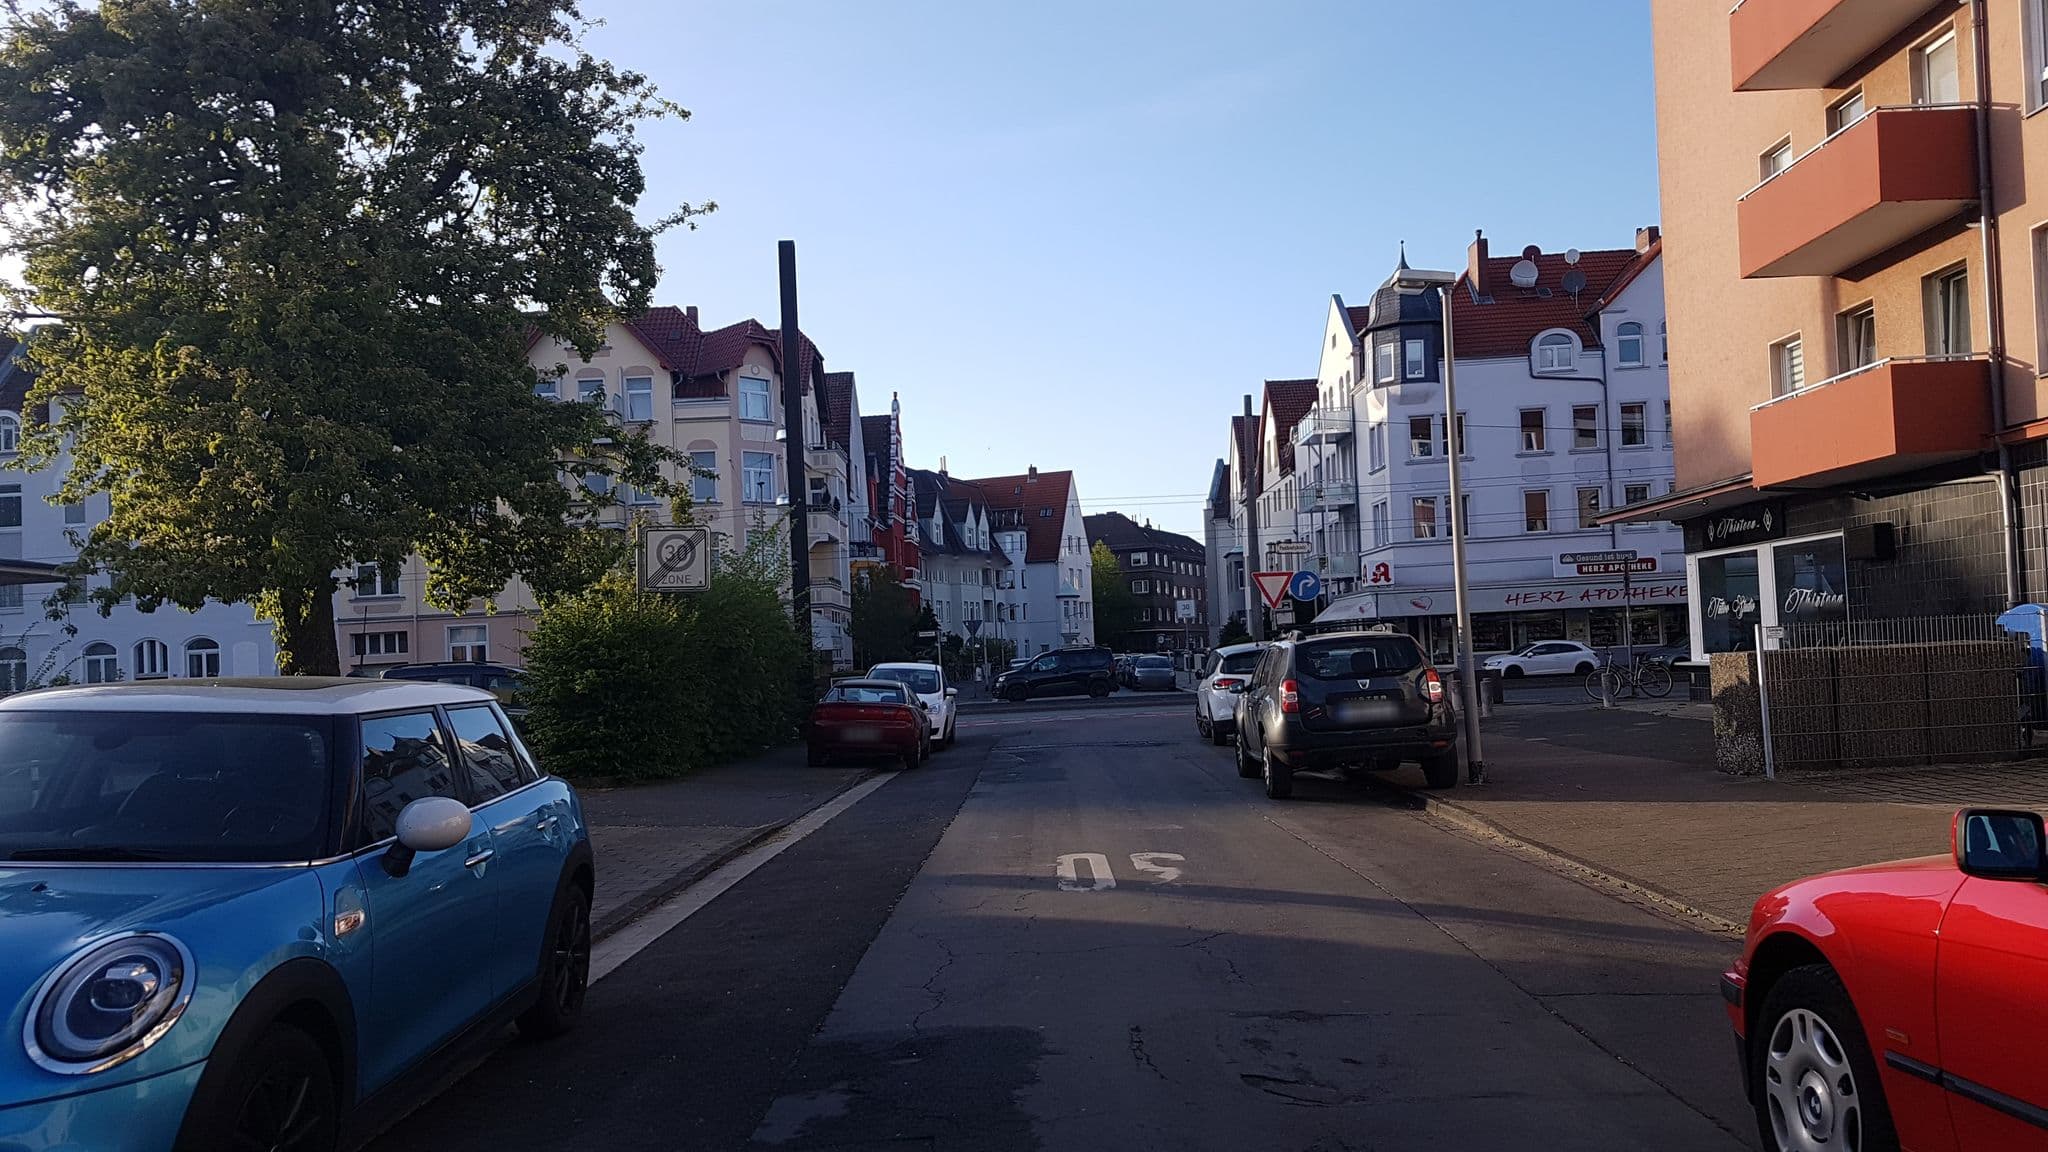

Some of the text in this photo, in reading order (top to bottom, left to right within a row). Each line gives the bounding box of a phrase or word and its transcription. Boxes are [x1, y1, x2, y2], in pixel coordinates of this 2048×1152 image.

[664, 544, 688, 562] 30
[1576, 553, 1603, 562] Gesund
[1582, 562, 1653, 573] HERZ APOTHEKE
[660, 574, 692, 585] ZONE
[1505, 585, 1688, 606] HERZ APOTHEKE
